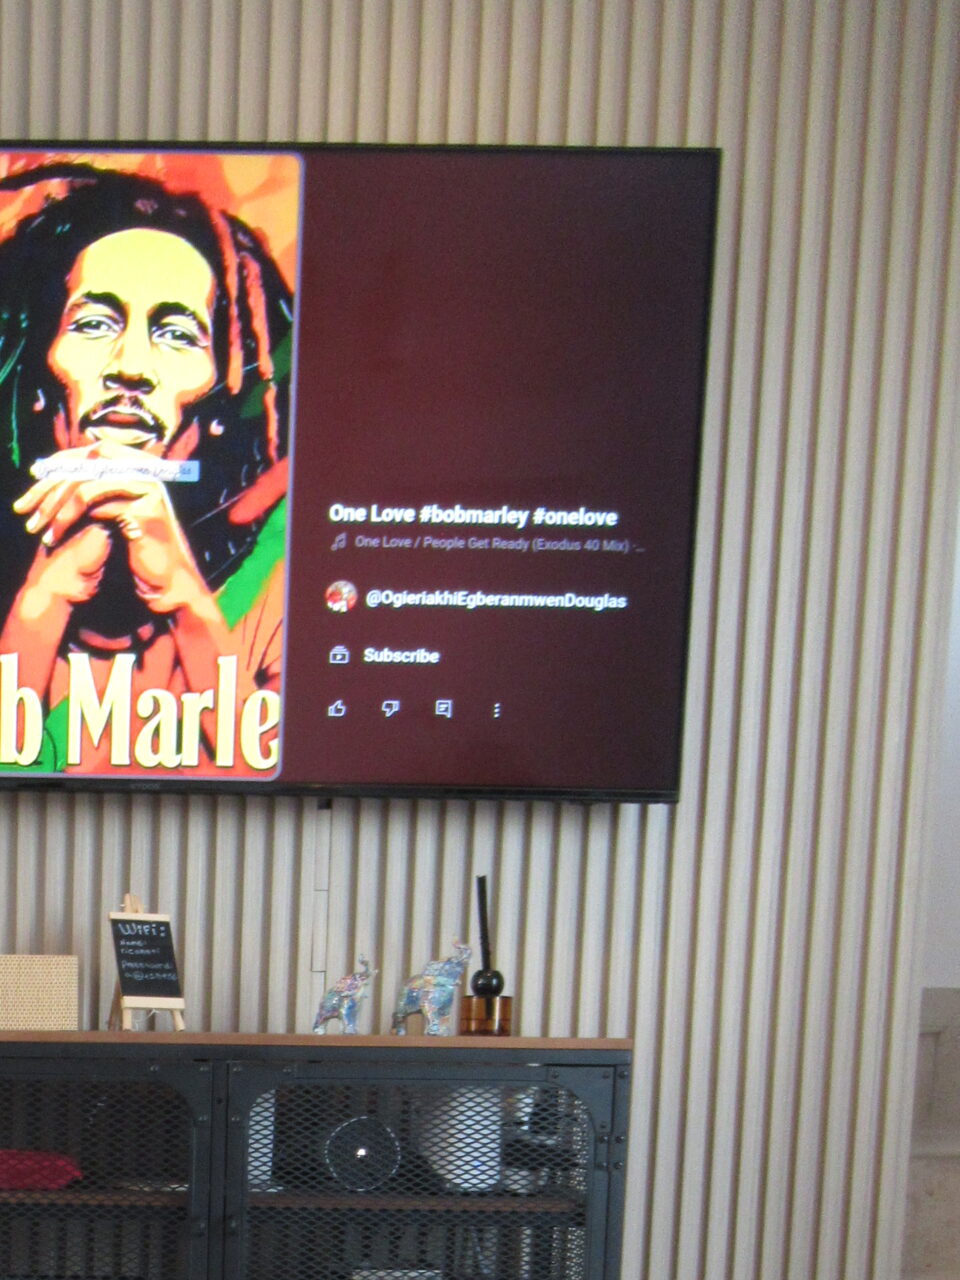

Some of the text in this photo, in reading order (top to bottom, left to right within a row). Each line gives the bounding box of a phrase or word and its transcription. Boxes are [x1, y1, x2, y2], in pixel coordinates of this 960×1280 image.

[328, 504, 619, 529] One Love #bobmarley #onelove
[354, 535, 381, 549] One
[382, 536, 412, 549] Love
[423, 536, 464, 552] People
[468, 537, 490, 550] Get
[492, 538, 530, 554] Ready
[532, 537, 582, 554] (Exodus
[584, 539, 601, 552] 40
[603, 539, 629, 554] Mix)
[363, 647, 440, 664] Subscribe
